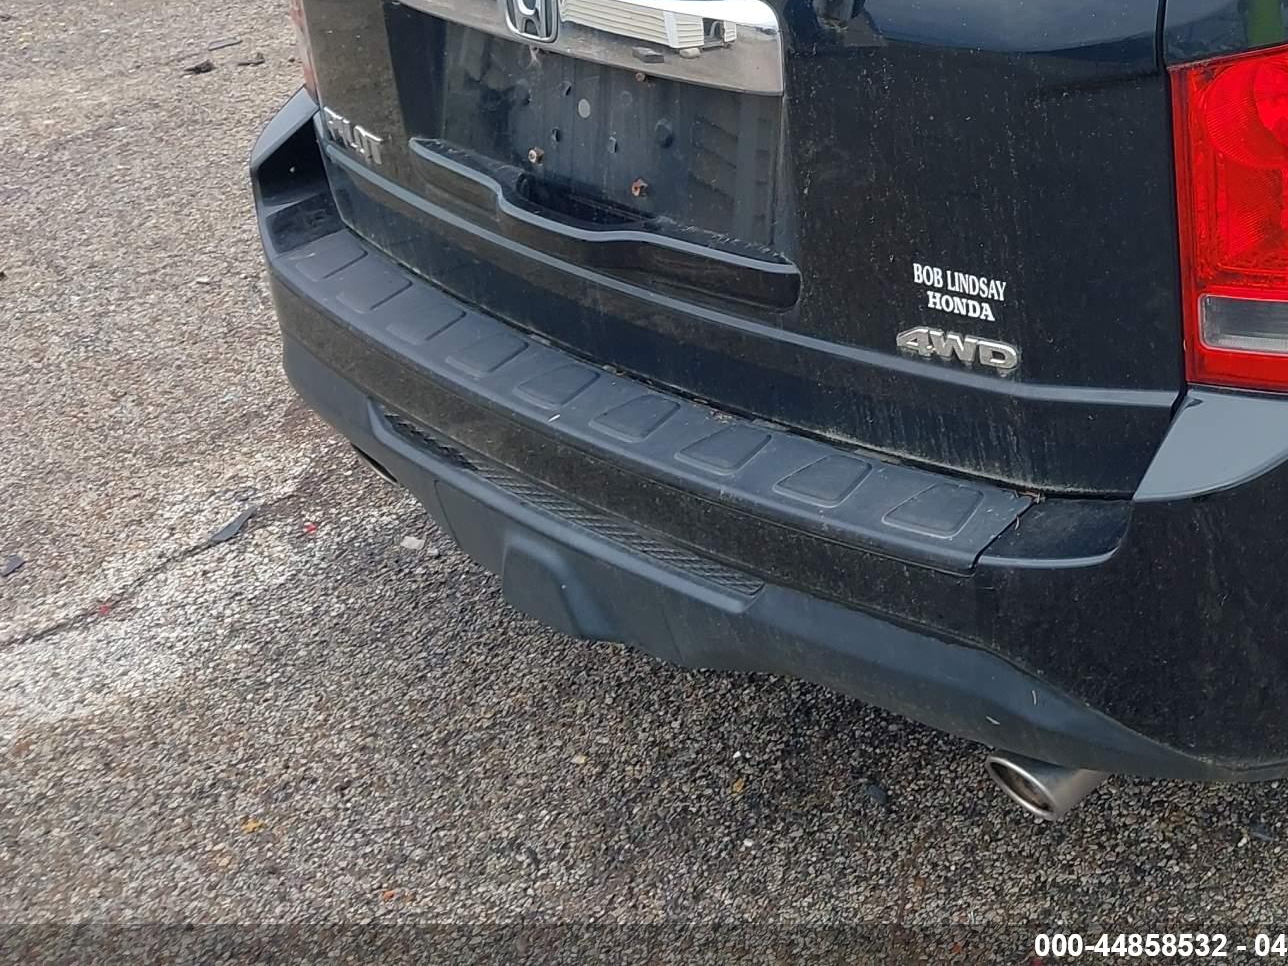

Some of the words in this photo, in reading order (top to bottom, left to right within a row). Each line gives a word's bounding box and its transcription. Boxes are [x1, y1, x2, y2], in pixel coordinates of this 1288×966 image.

[913, 263, 943, 288] BOB
[946, 270, 1006, 301] LINDSAY
[927, 291, 995, 321] HONDA
[896, 326, 1020, 370] 4WD
